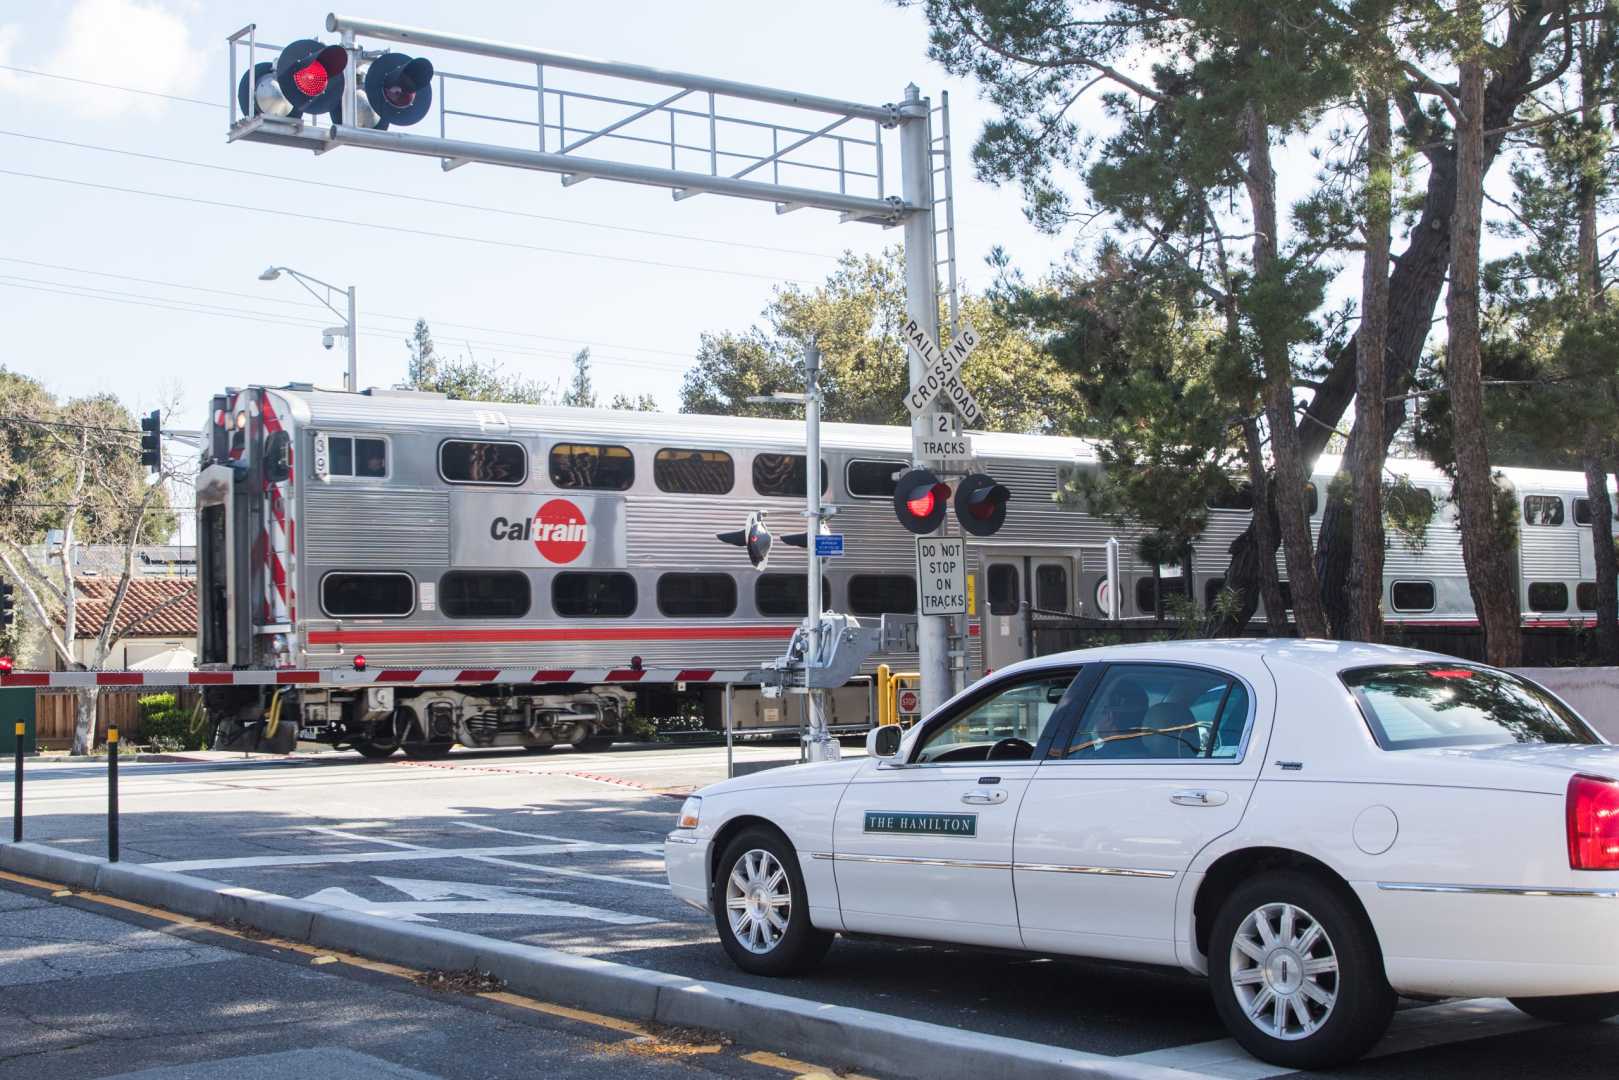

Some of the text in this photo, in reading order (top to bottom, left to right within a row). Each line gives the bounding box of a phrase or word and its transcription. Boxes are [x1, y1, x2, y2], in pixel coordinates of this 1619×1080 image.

[906, 320, 976, 418] RAIL ROAD
[911, 331, 974, 409] CROSSING
[938, 416, 948, 432] 2
[923, 442, 965, 454] TRACKS
[490, 517, 588, 542] Caltrain
[922, 544, 961, 557] DO NOT
[929, 562, 957, 574] STOP
[936, 579, 952, 590] ON
[923, 594, 964, 608] TRACKS
[869, 816, 971, 831] THE HAMILTON
